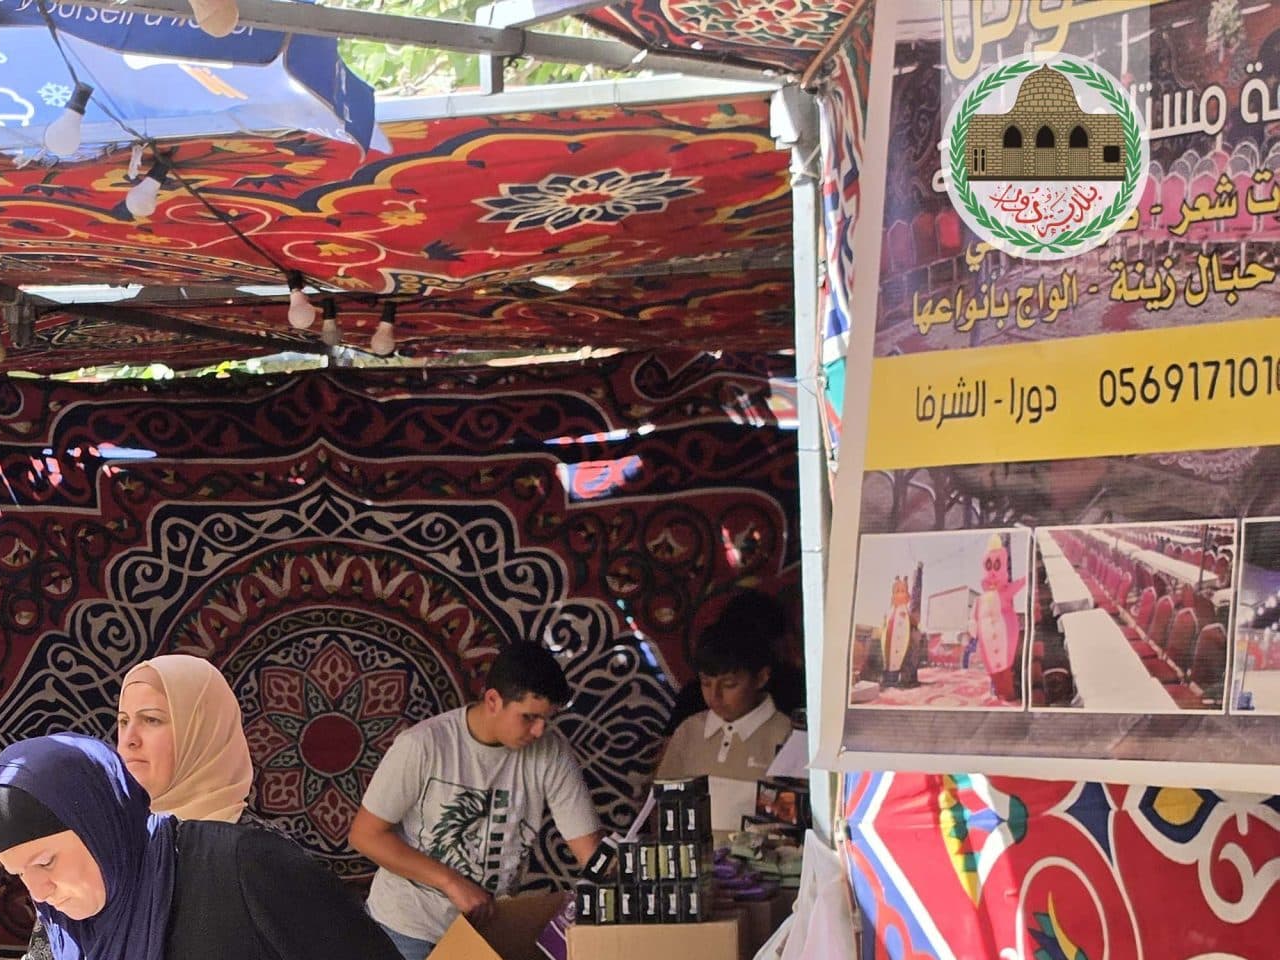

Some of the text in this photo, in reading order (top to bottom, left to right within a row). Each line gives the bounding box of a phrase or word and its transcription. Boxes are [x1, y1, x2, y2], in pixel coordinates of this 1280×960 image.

[1168, 174, 1239, 237] شعر
[1108, 256, 1176, 311] زينة
[1184, 252, 1277, 307] حبال
[915, 376, 986, 430] الشرفا
[1009, 376, 1059, 425] دورا
[1099, 355, 1280, 408] 056917101
